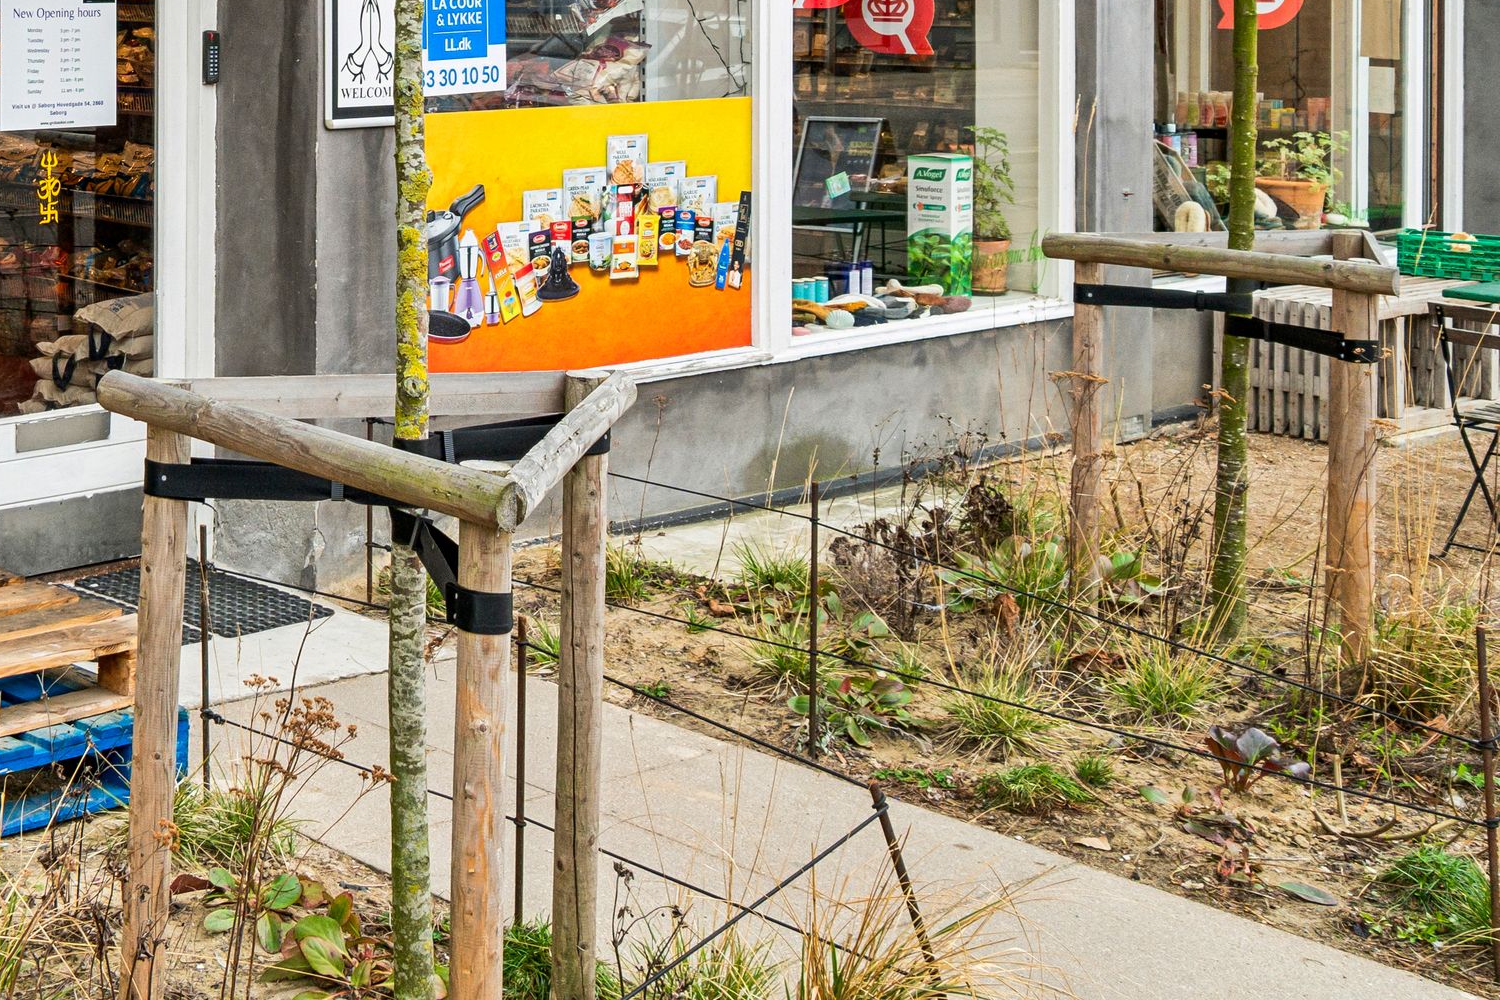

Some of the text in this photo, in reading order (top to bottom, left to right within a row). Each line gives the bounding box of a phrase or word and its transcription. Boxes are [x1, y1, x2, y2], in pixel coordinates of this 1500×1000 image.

[12, 7, 101, 20] New Opening hours
[436, 12, 483, 27] & LYKKE
[445, 37, 472, 52] LL.dk
[439, 68, 457, 87] 30
[461, 67, 479, 85] 10
[482, 65, 500, 84] 50
[341, 86, 392, 99] WELCOM
